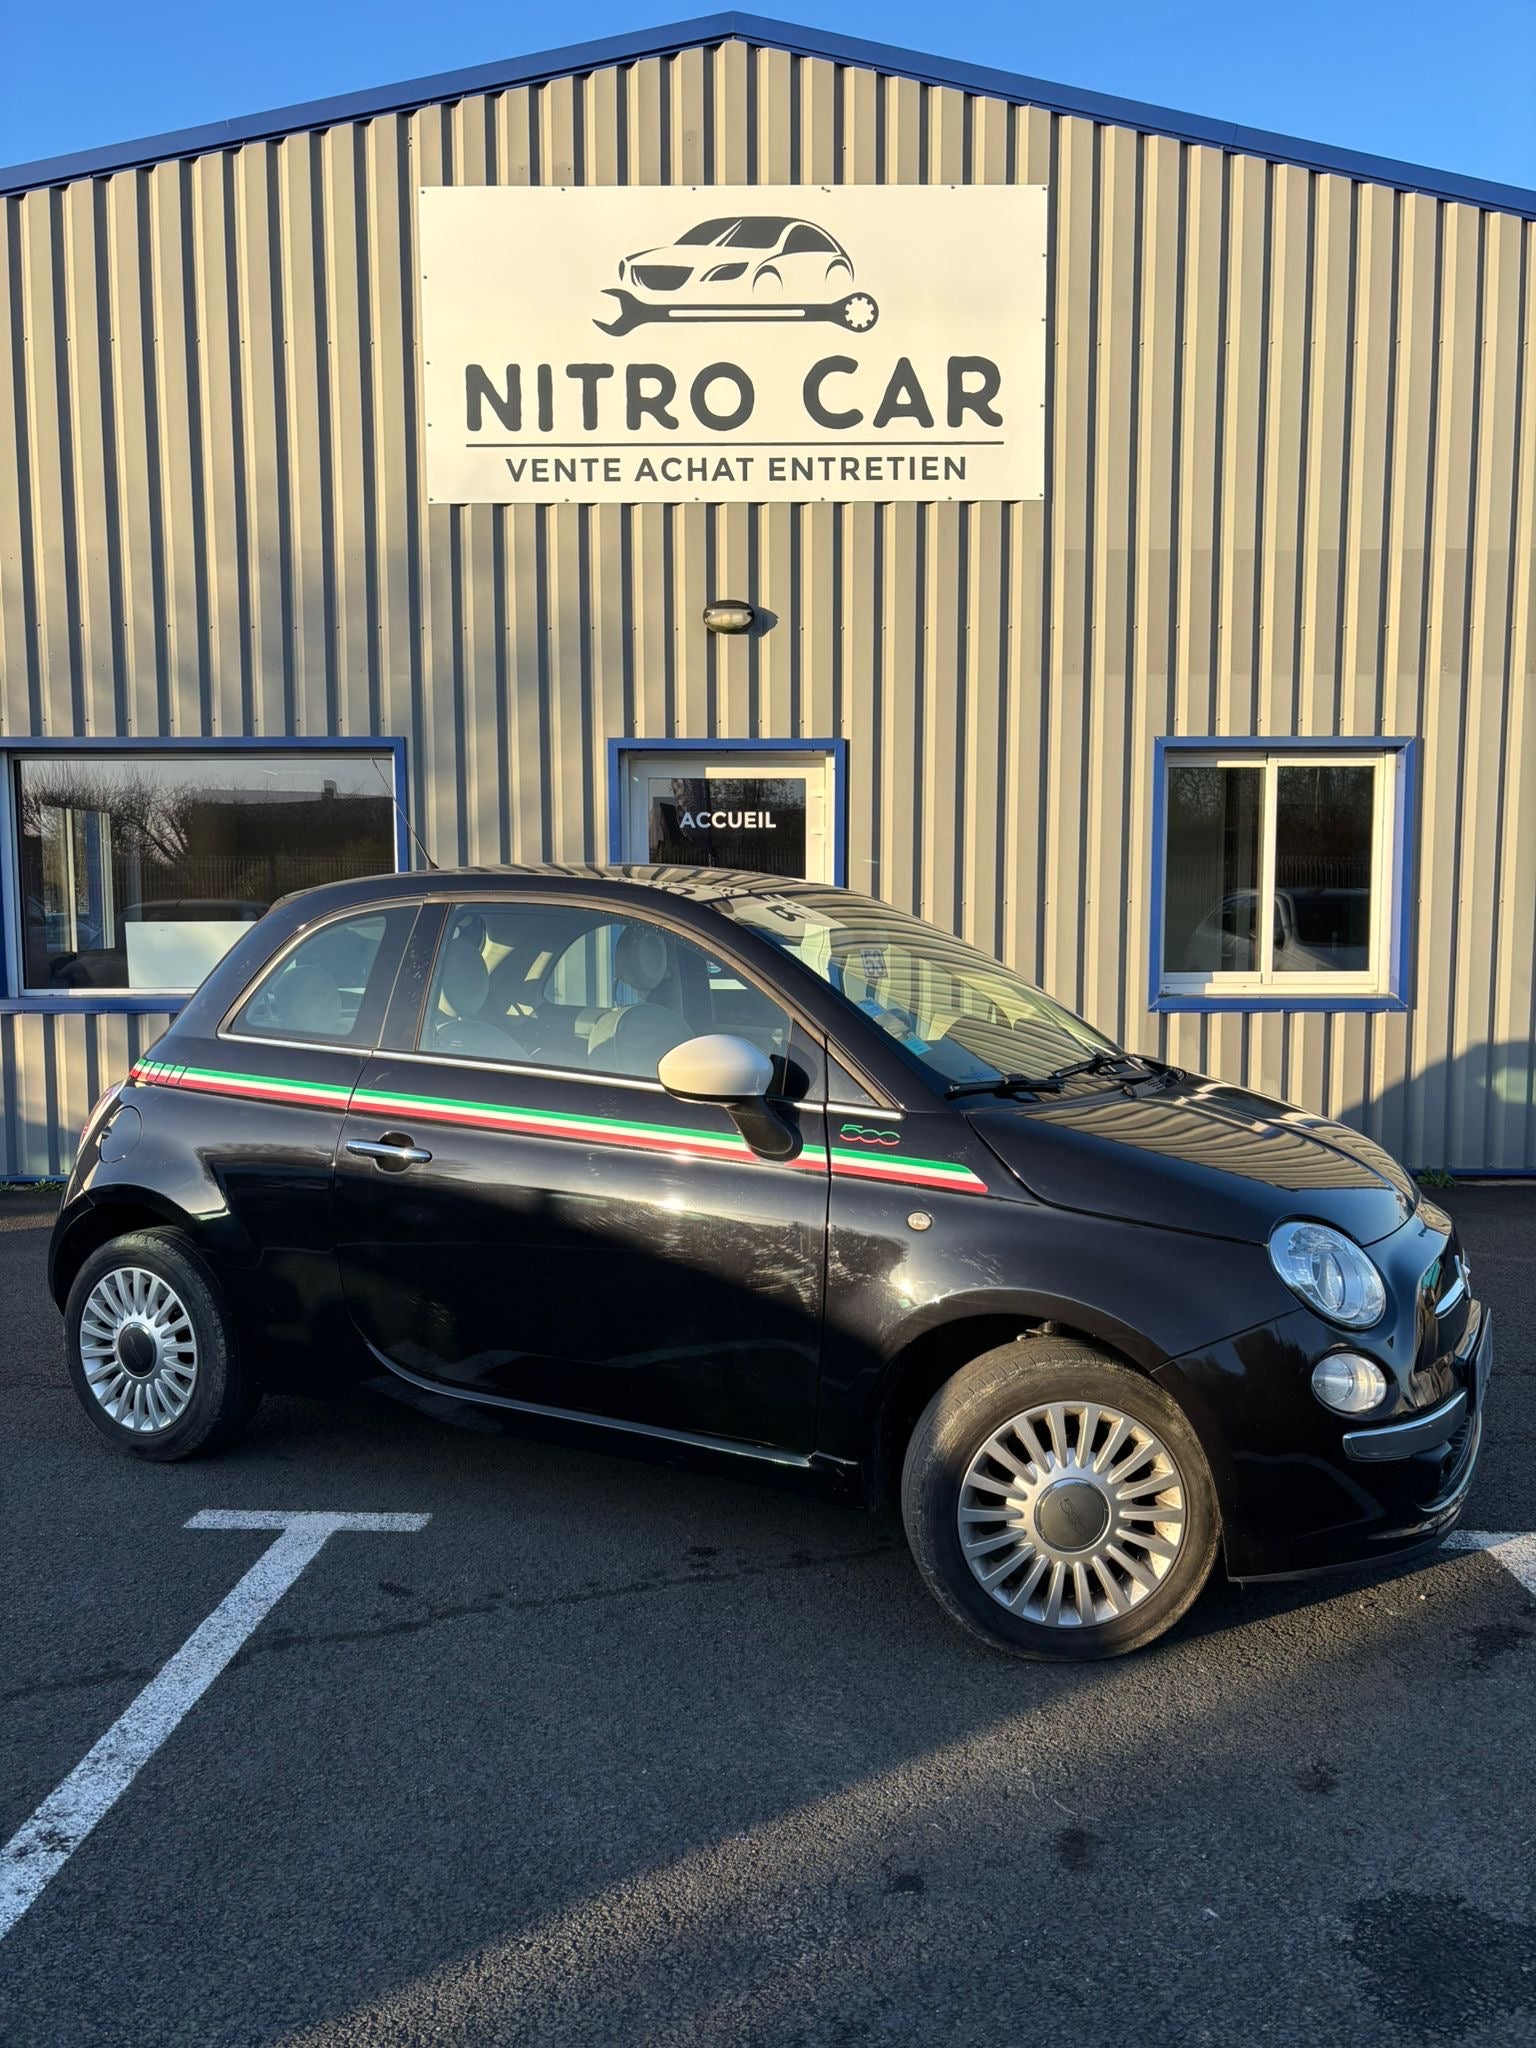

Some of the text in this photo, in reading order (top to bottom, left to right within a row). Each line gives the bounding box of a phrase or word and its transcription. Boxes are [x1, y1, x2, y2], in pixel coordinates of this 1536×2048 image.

[465, 355, 1004, 432] NITRO CAR
[505, 456, 966, 483] VENTE ACHAT ENTRETIEN
[679, 811, 777, 829] ACCUEIL
[840, 1124, 900, 1147] 500
